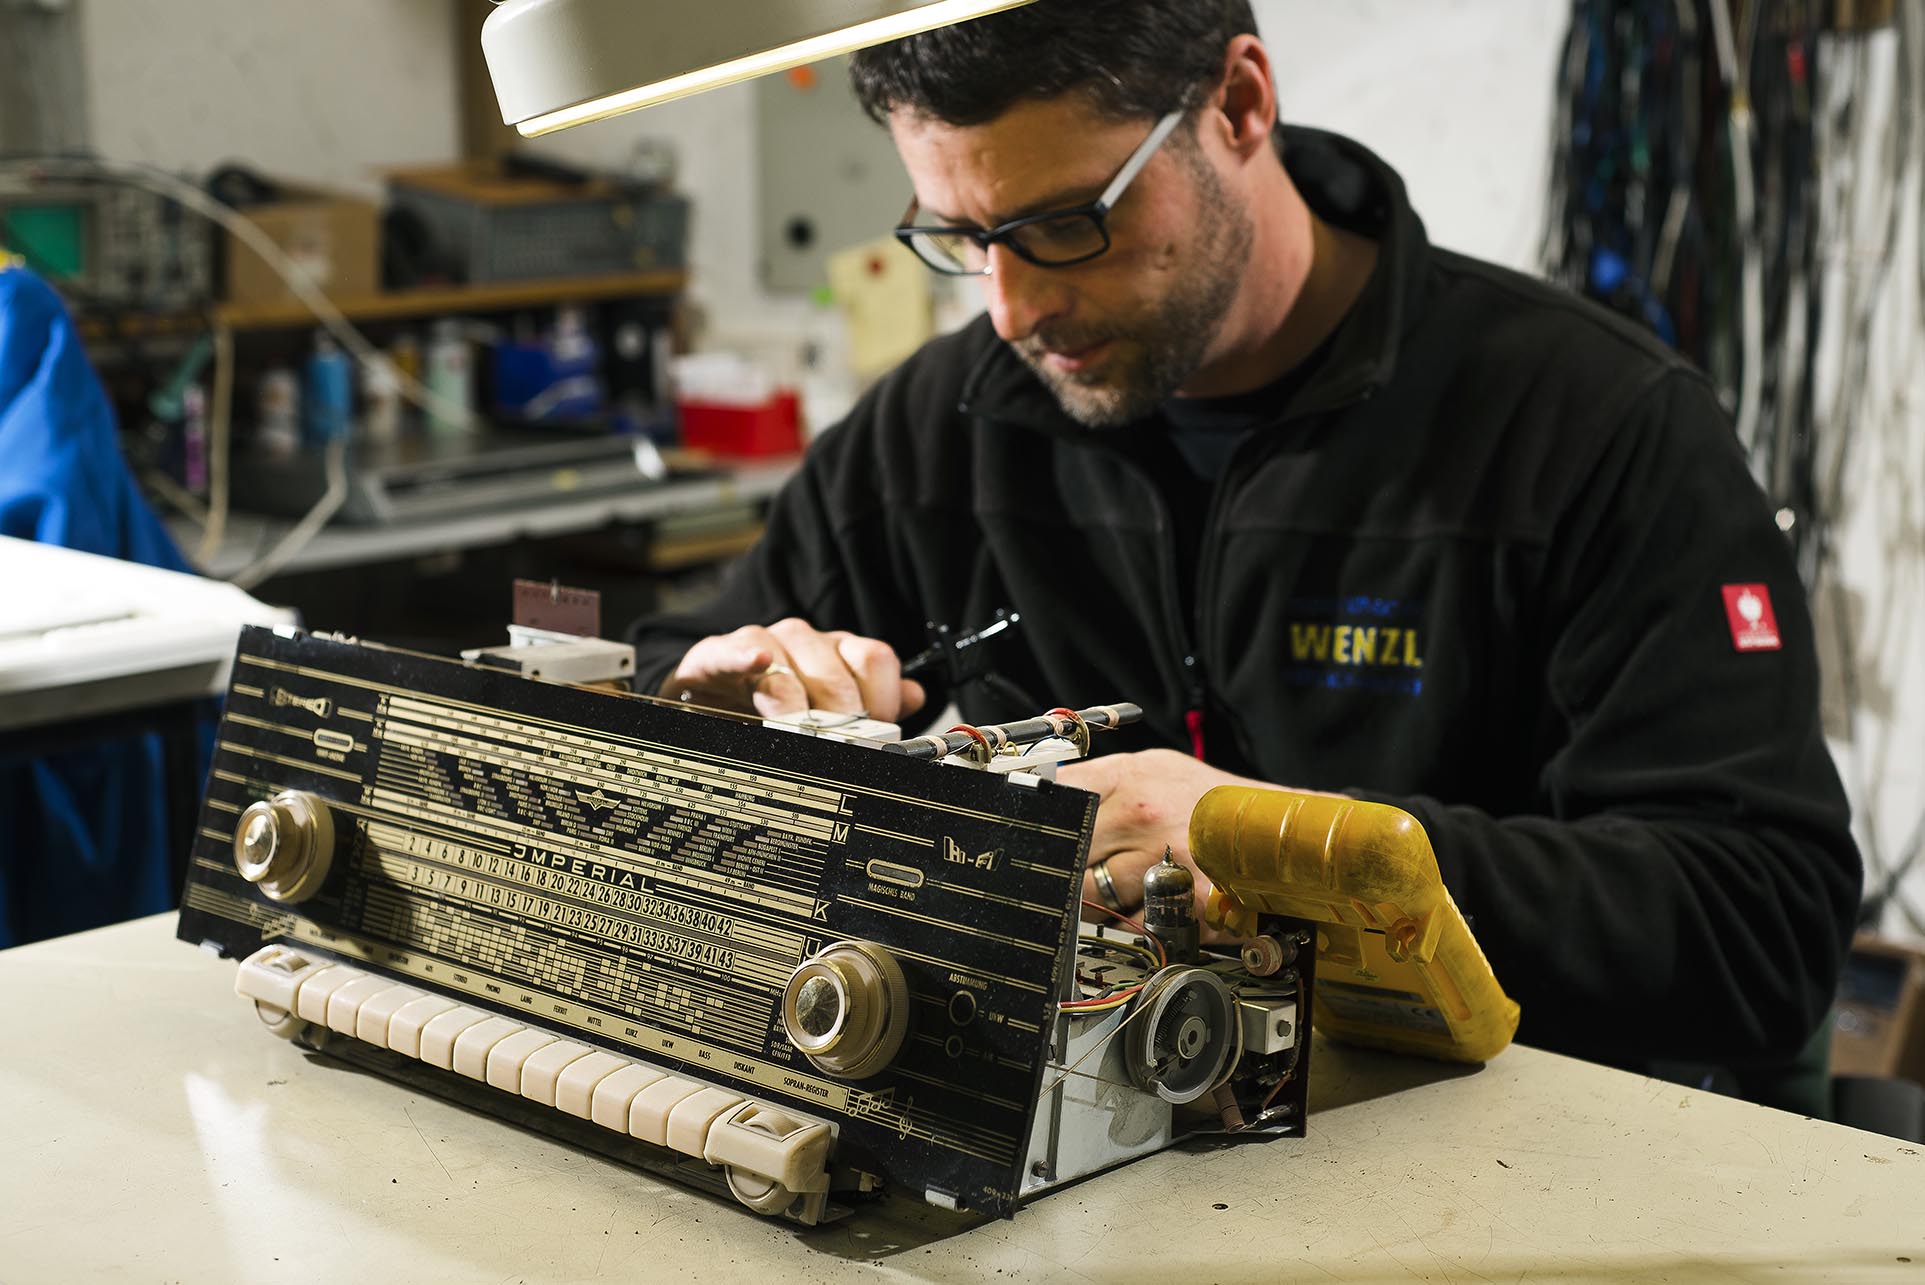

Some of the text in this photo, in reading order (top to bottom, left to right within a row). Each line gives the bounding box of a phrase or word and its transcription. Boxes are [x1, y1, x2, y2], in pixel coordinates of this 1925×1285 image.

[1290, 624, 1422, 667] WENZL
[833, 823, 849, 844] M
[409, 837, 731, 937] 2 4 6 8 10 12 14 16 18 20 22 24 26 28 30 32 34 36 38 40 42
[867, 882, 916, 901] MAGISCHES BAND
[412, 867, 733, 969] 3 5 7 9 11 13 15 17 19 21 23 25 27 29 31 33 35 37 39 41 43
[812, 902, 831, 922] K
[646, 953, 654, 961] 97
[670, 960, 678, 968] 98
[695, 967, 704, 975] 99
[720, 973, 731, 983] 100
[949, 973, 989, 991] ABSTIMMUNG
[485, 983, 501, 994] PHONO
[520, 994, 533, 1005] LANG
[625, 1027, 638, 1039] KURZ
[661, 1038, 675, 1050] UKW
[698, 1049, 711, 1061] BASS
[733, 1060, 756, 1075] DISKANT
[783, 1076, 829, 1099] SOPRAN-REGISTER
